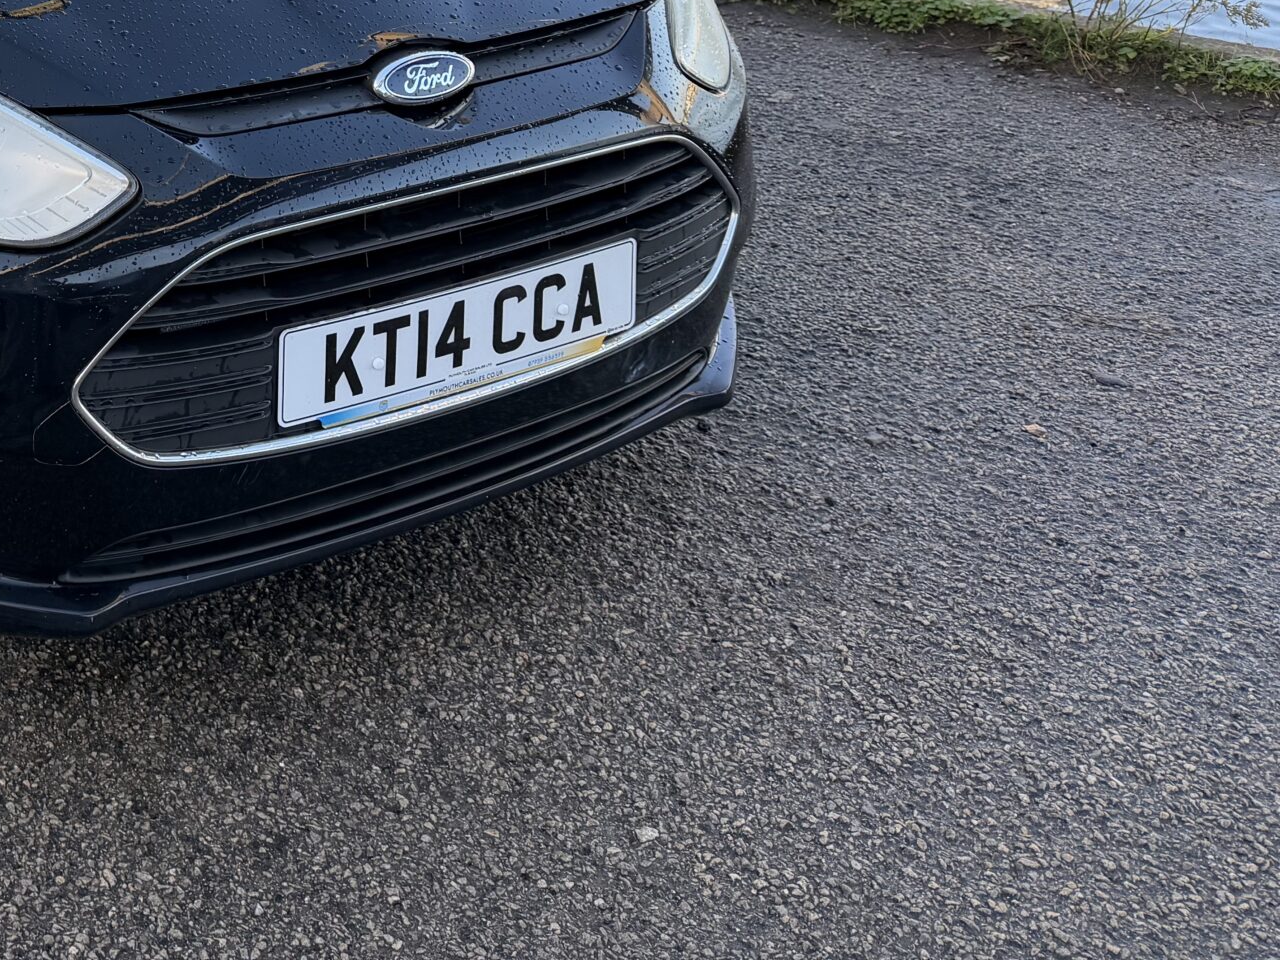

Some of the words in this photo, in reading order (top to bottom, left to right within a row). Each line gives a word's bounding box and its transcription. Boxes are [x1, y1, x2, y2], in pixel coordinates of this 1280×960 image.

[404, 61, 455, 94] Ford
[323, 299, 471, 404] KT14
[492, 262, 603, 355] CCA
